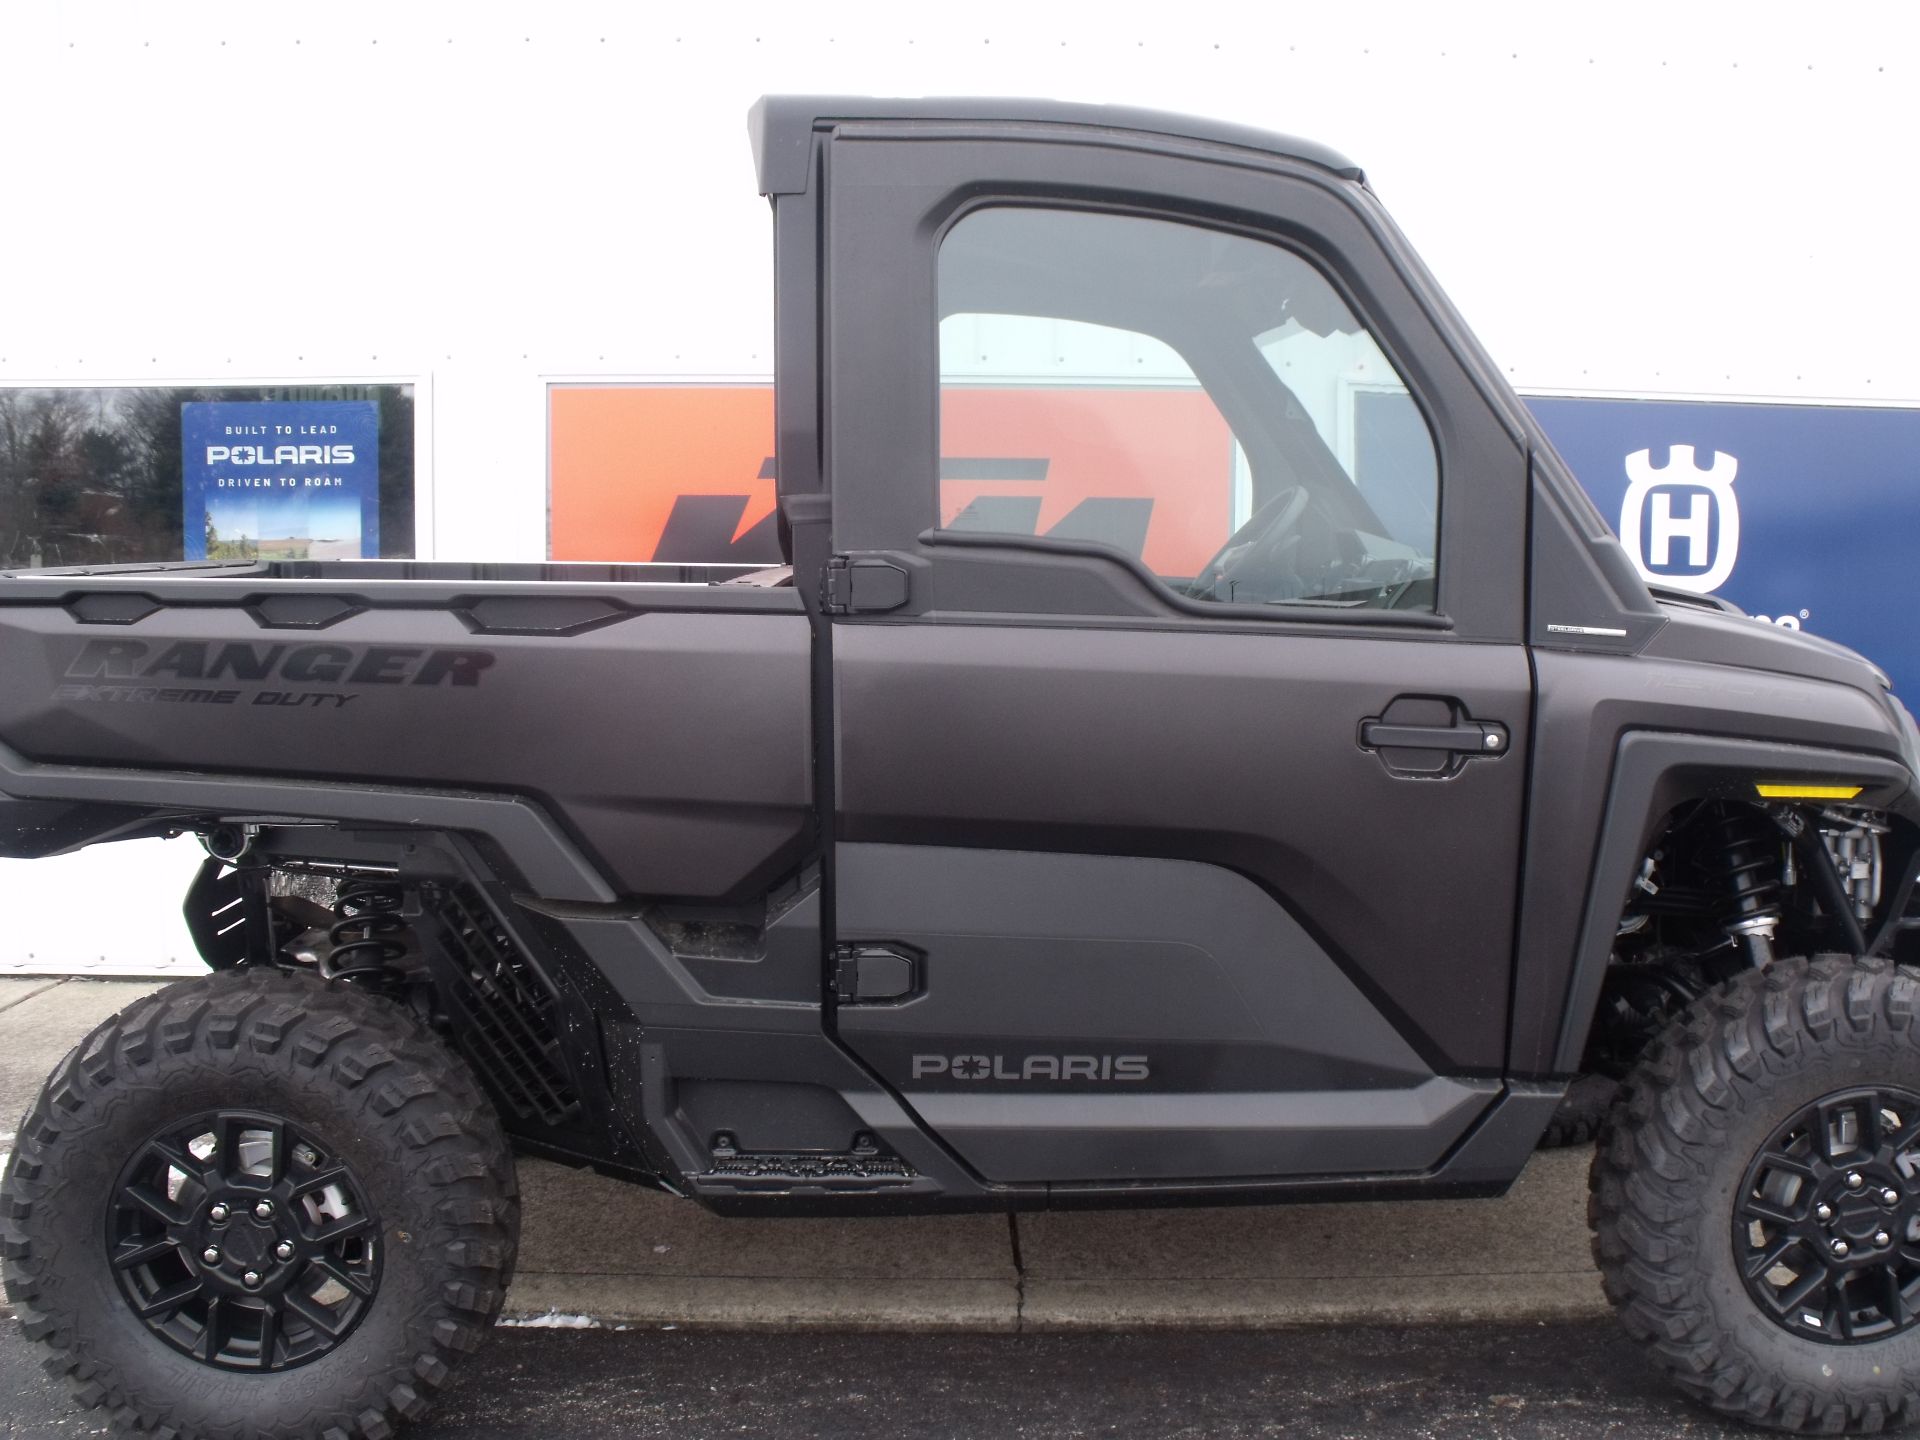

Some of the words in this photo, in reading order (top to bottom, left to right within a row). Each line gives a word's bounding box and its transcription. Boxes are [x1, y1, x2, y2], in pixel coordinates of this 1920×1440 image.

[225, 425, 268, 435] BUILT
[275, 425, 292, 435] TO
[300, 425, 338, 435] LEAD
[206, 444, 356, 465] POLARIS
[218, 478, 271, 487] DRIVEN
[279, 478, 296, 487] TO
[304, 477, 343, 486] ROAM
[63, 636, 498, 688] RANGER
[49, 683, 239, 705] EXTREME
[251, 689, 362, 709] DUTY
[912, 1054, 1151, 1081] POLARIS
[163, 1365, 264, 1408] TRAIL
